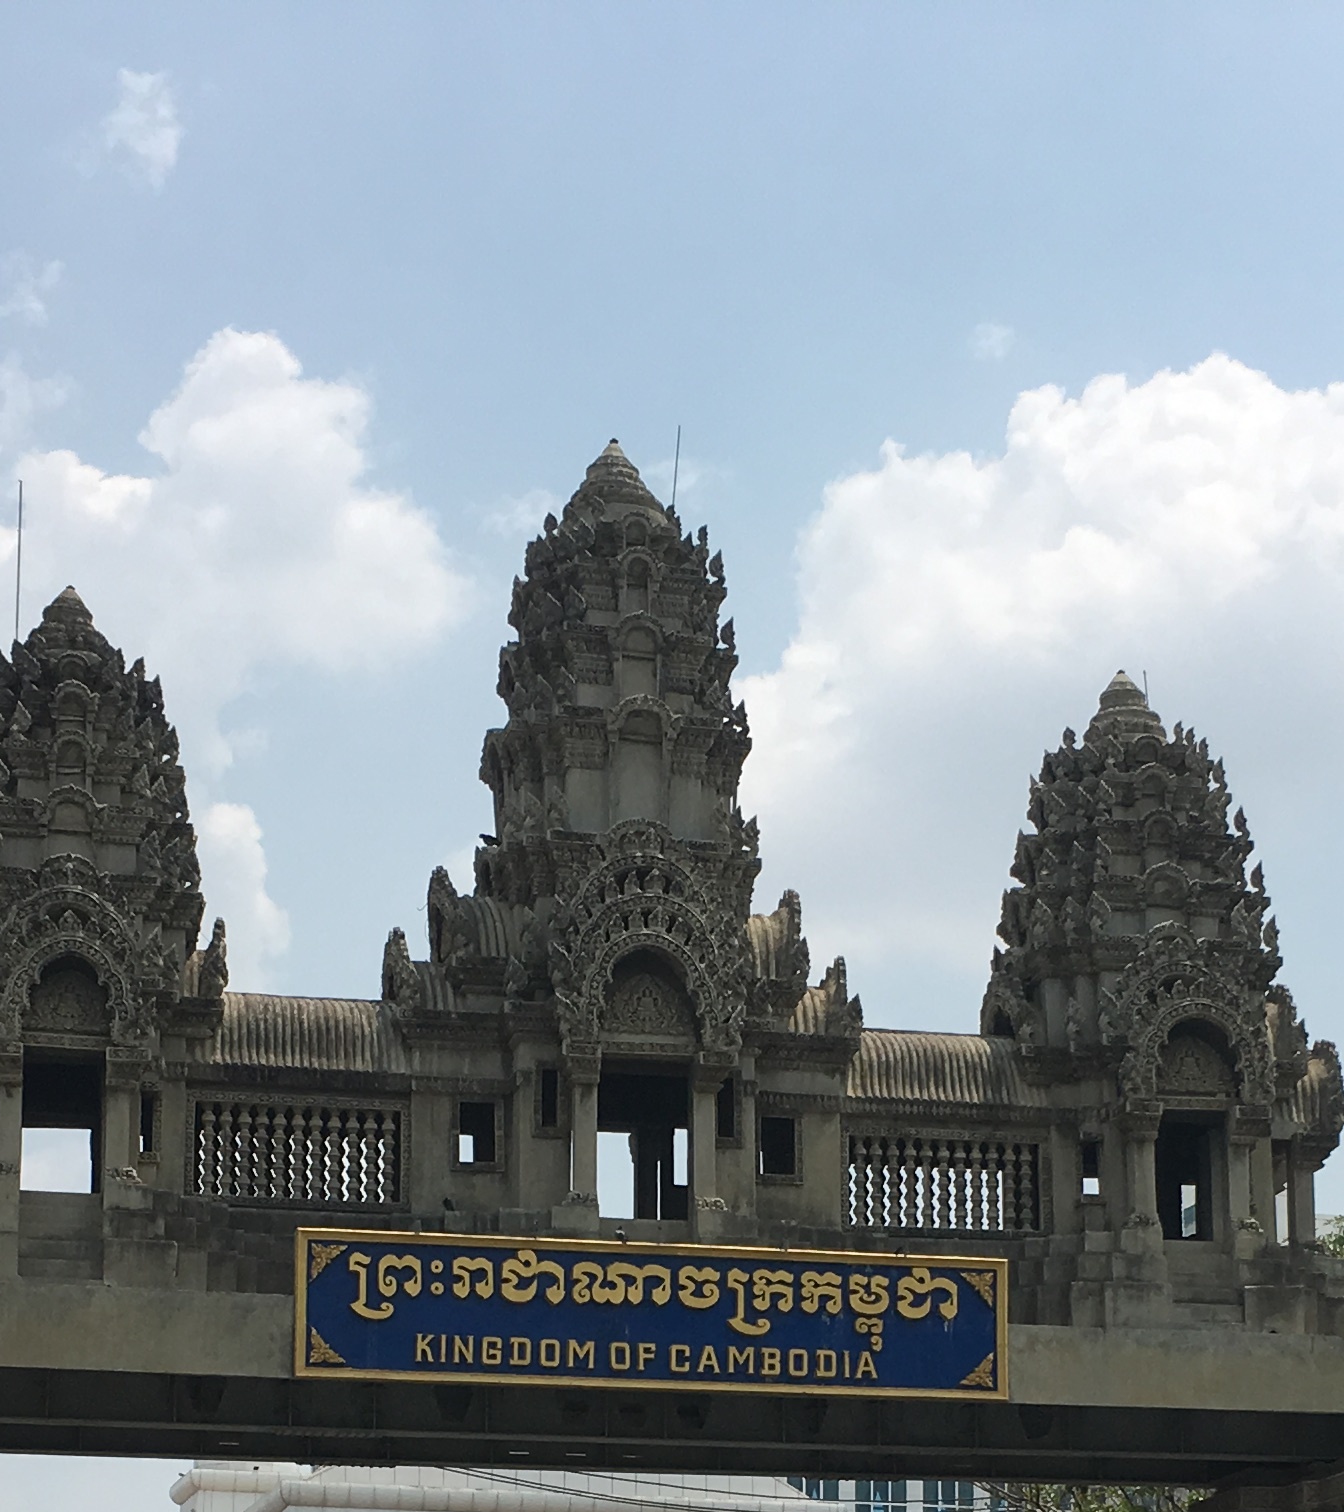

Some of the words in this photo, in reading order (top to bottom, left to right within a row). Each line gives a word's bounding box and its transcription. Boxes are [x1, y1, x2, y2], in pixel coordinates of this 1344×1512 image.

[348, 1248, 959, 1351] ព្រះរាជាណាចក្រកម្ពុជា
[415, 1332, 595, 1369] KINGDOM
[610, 1341, 656, 1371] OF
[670, 1344, 880, 1380] CAMBODIA
